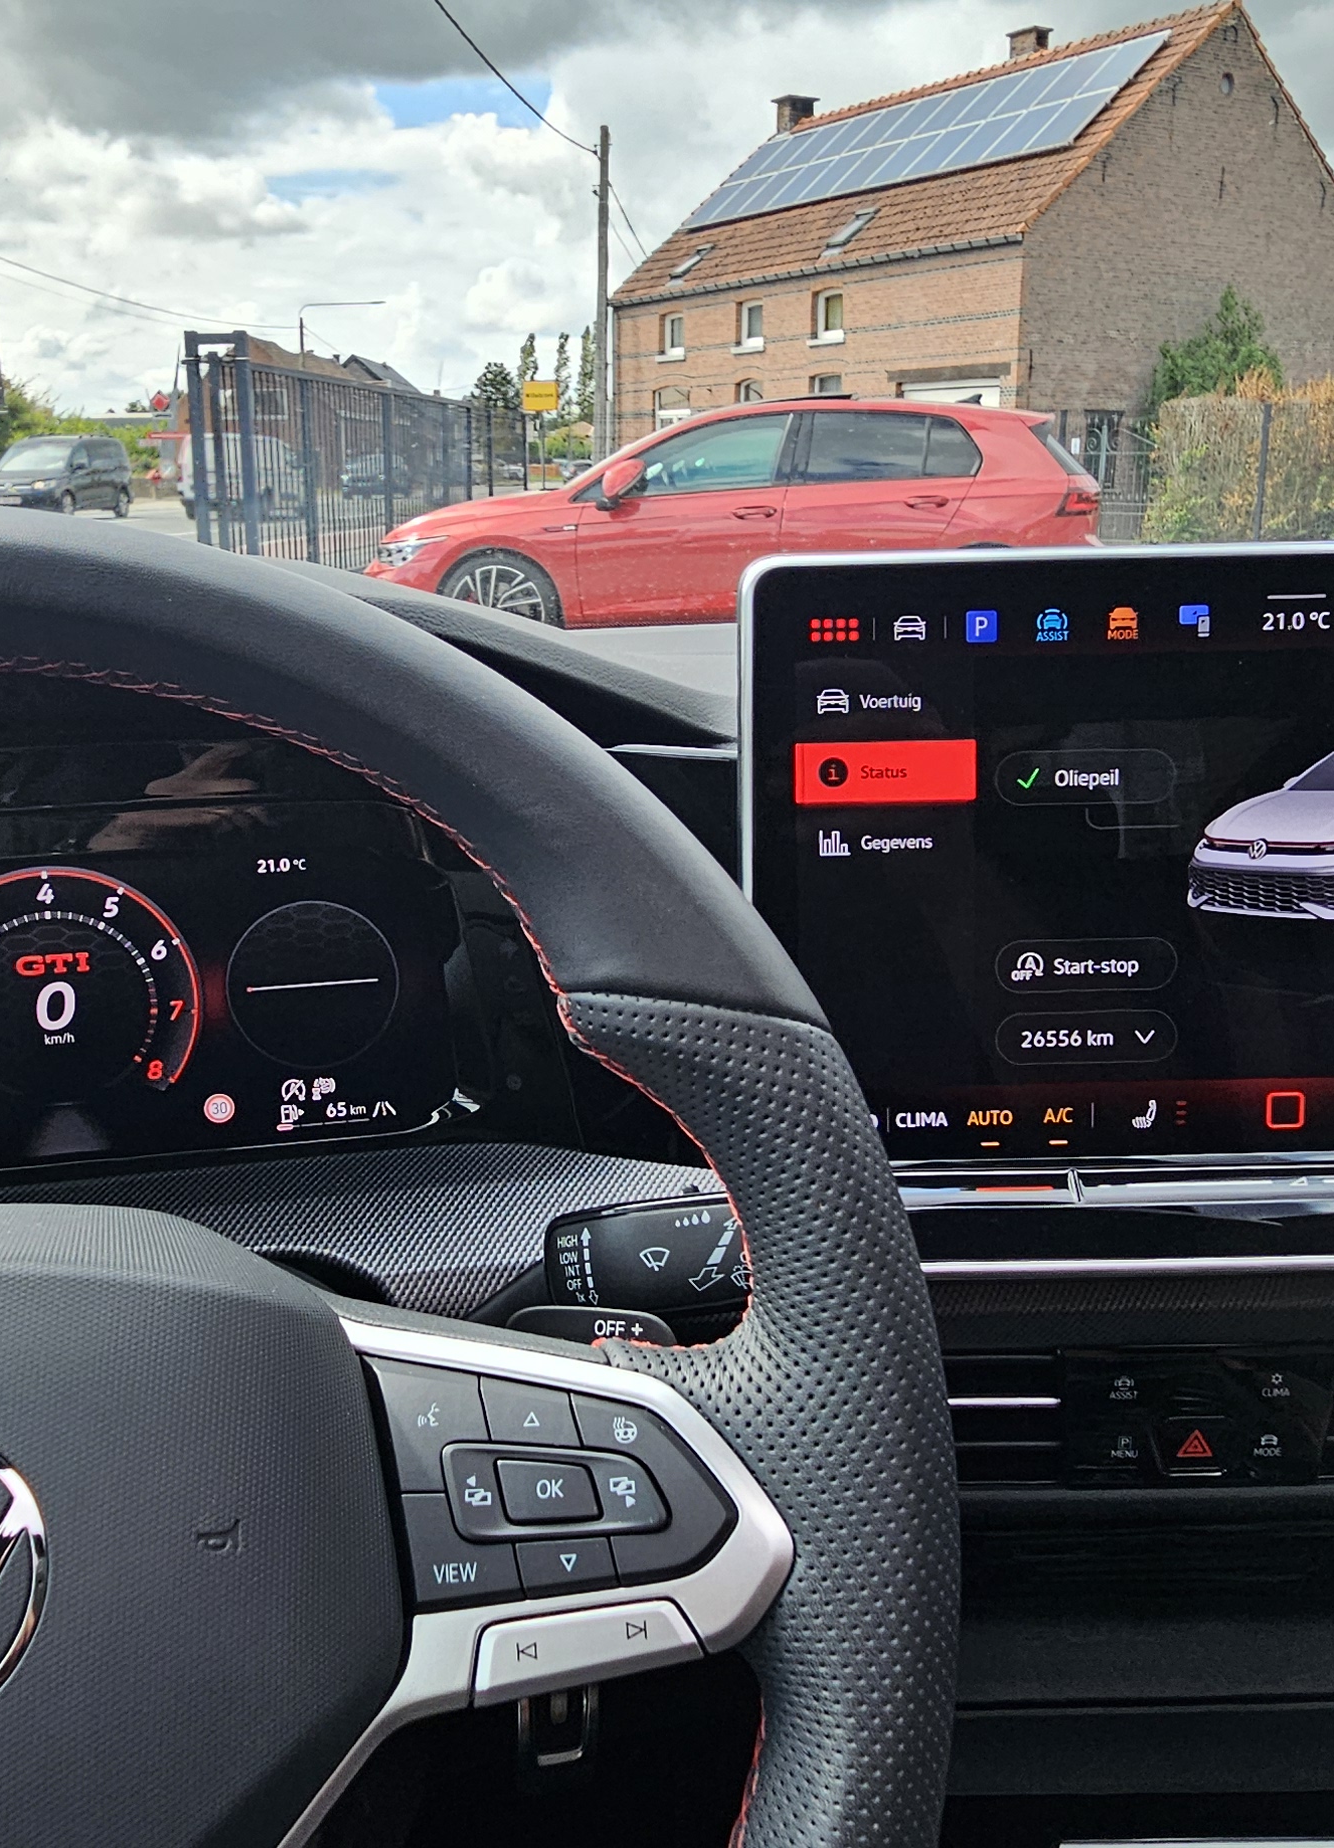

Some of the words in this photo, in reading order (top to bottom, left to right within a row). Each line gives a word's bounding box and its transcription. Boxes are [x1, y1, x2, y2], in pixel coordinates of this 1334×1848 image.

[974, 616, 989, 637] P
[1262, 611, 1305, 631] 21.0
[1036, 630, 1070, 642] ASSIST
[1107, 629, 1139, 640] MODE
[858, 692, 923, 712] Voertuig
[860, 763, 908, 780] Status
[1054, 767, 1120, 790] Oliepeil
[860, 833, 934, 854] Gegevens
[257, 858, 291, 874] 21.0
[36, 883, 55, 904] 4
[102, 896, 120, 918] 5
[150, 938, 168, 961] 6
[15, 952, 91, 978] GTI
[1053, 957, 1140, 978] Start-stop
[1010, 969, 1034, 982] OFF
[36, 981, 77, 1032] 0
[169, 1000, 185, 1022] 7
[43, 1031, 76, 1047] km/h
[1020, 1030, 1082, 1049] 26556
[1086, 1029, 1114, 1047] km
[146, 1059, 164, 1081] 8
[210, 1101, 229, 1116] 30
[326, 1101, 347, 1118] 65
[349, 1102, 367, 1116] km
[1042, 1107, 1075, 1124] A/C
[895, 1111, 949, 1128] CLIMA
[967, 1109, 1014, 1126] AUTO
[557, 1234, 579, 1249] HIGH
[559, 1251, 579, 1265] LOW
[565, 1264, 581, 1277] INT
[566, 1278, 583, 1291] OFF
[593, 1319, 627, 1337] OFF
[1109, 1390, 1139, 1400] ASSIST
[1261, 1387, 1291, 1398] CLIMA
[1110, 1449, 1139, 1459] MENU
[1253, 1447, 1283, 1457] MODE
[536, 1477, 565, 1500] OK
[432, 1561, 478, 1586] VIEW
